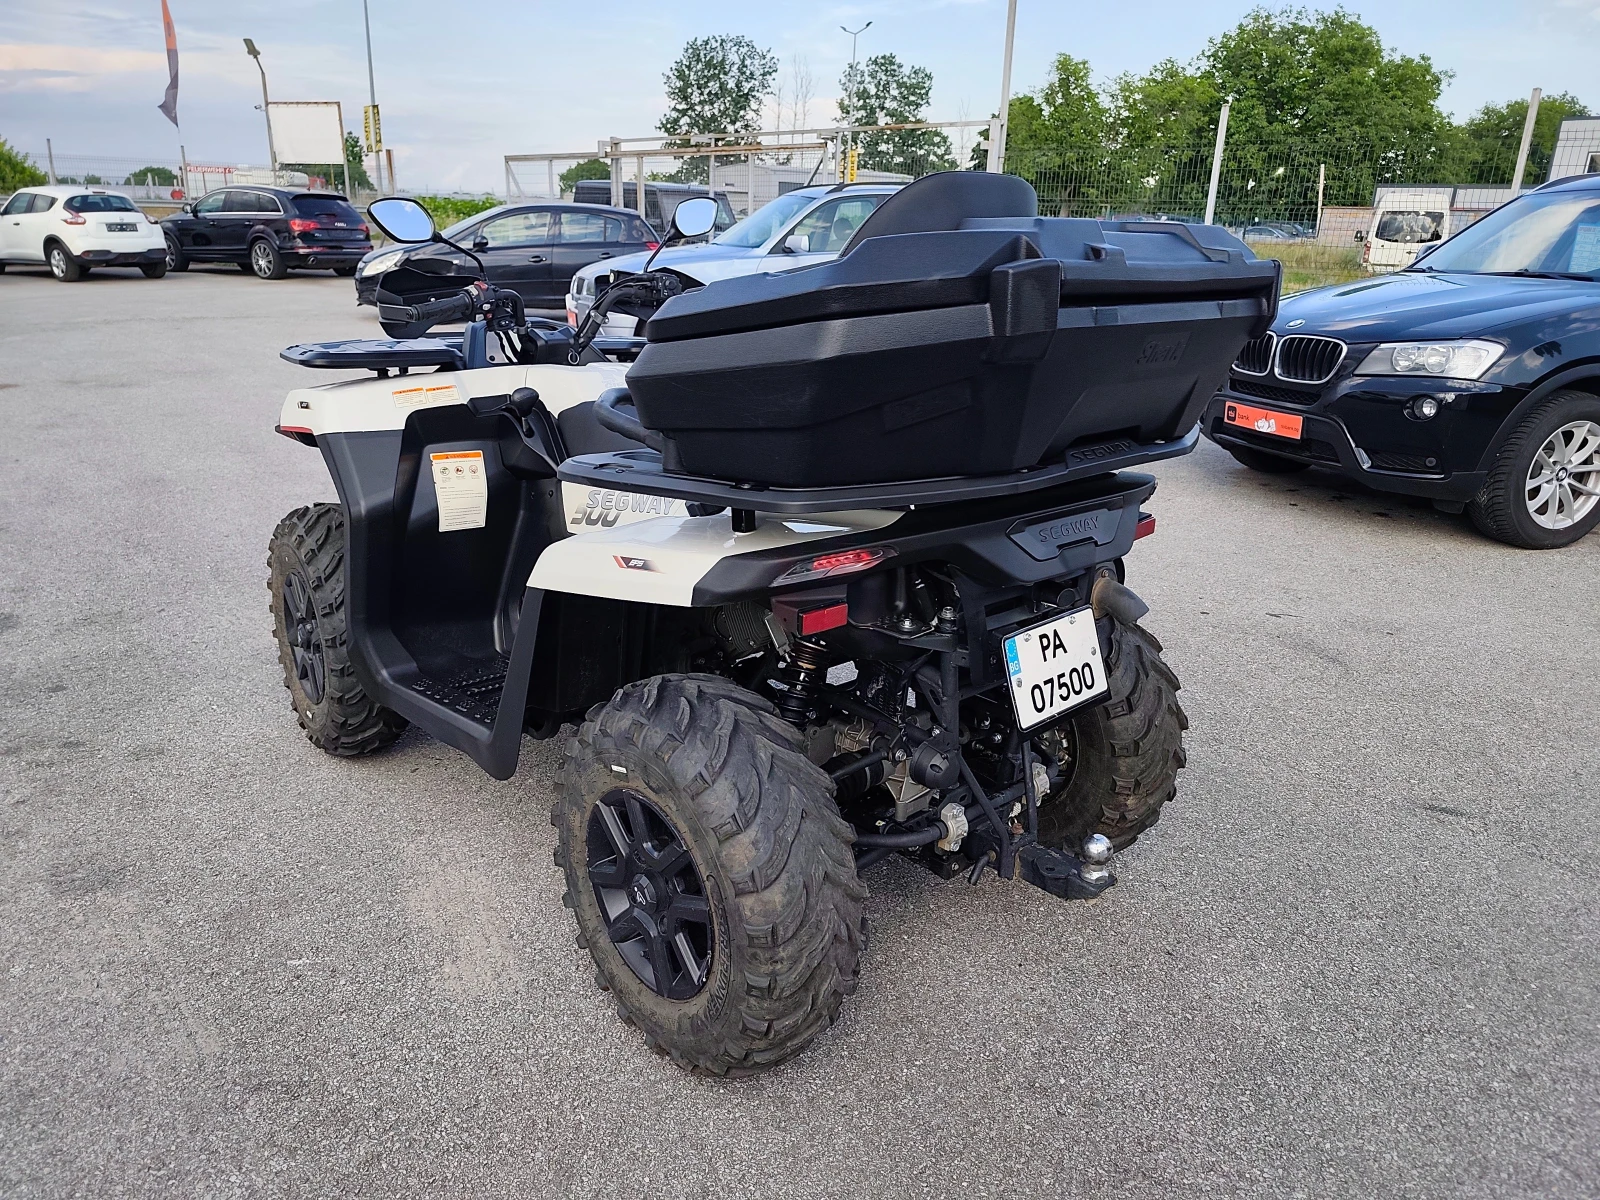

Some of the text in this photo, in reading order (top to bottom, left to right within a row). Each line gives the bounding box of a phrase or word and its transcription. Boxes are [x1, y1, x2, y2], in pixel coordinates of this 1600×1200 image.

[1237, 412, 1250, 421] bank
[1069, 440, 1131, 462] SEGWAY
[585, 489, 675, 515] SEGWAY
[1038, 515, 1099, 543] SEGWAY
[628, 559, 646, 567] EPS
[1038, 628, 1068, 663] PA
[1009, 660, 1020, 673] BG
[1030, 662, 1095, 713] 07500
